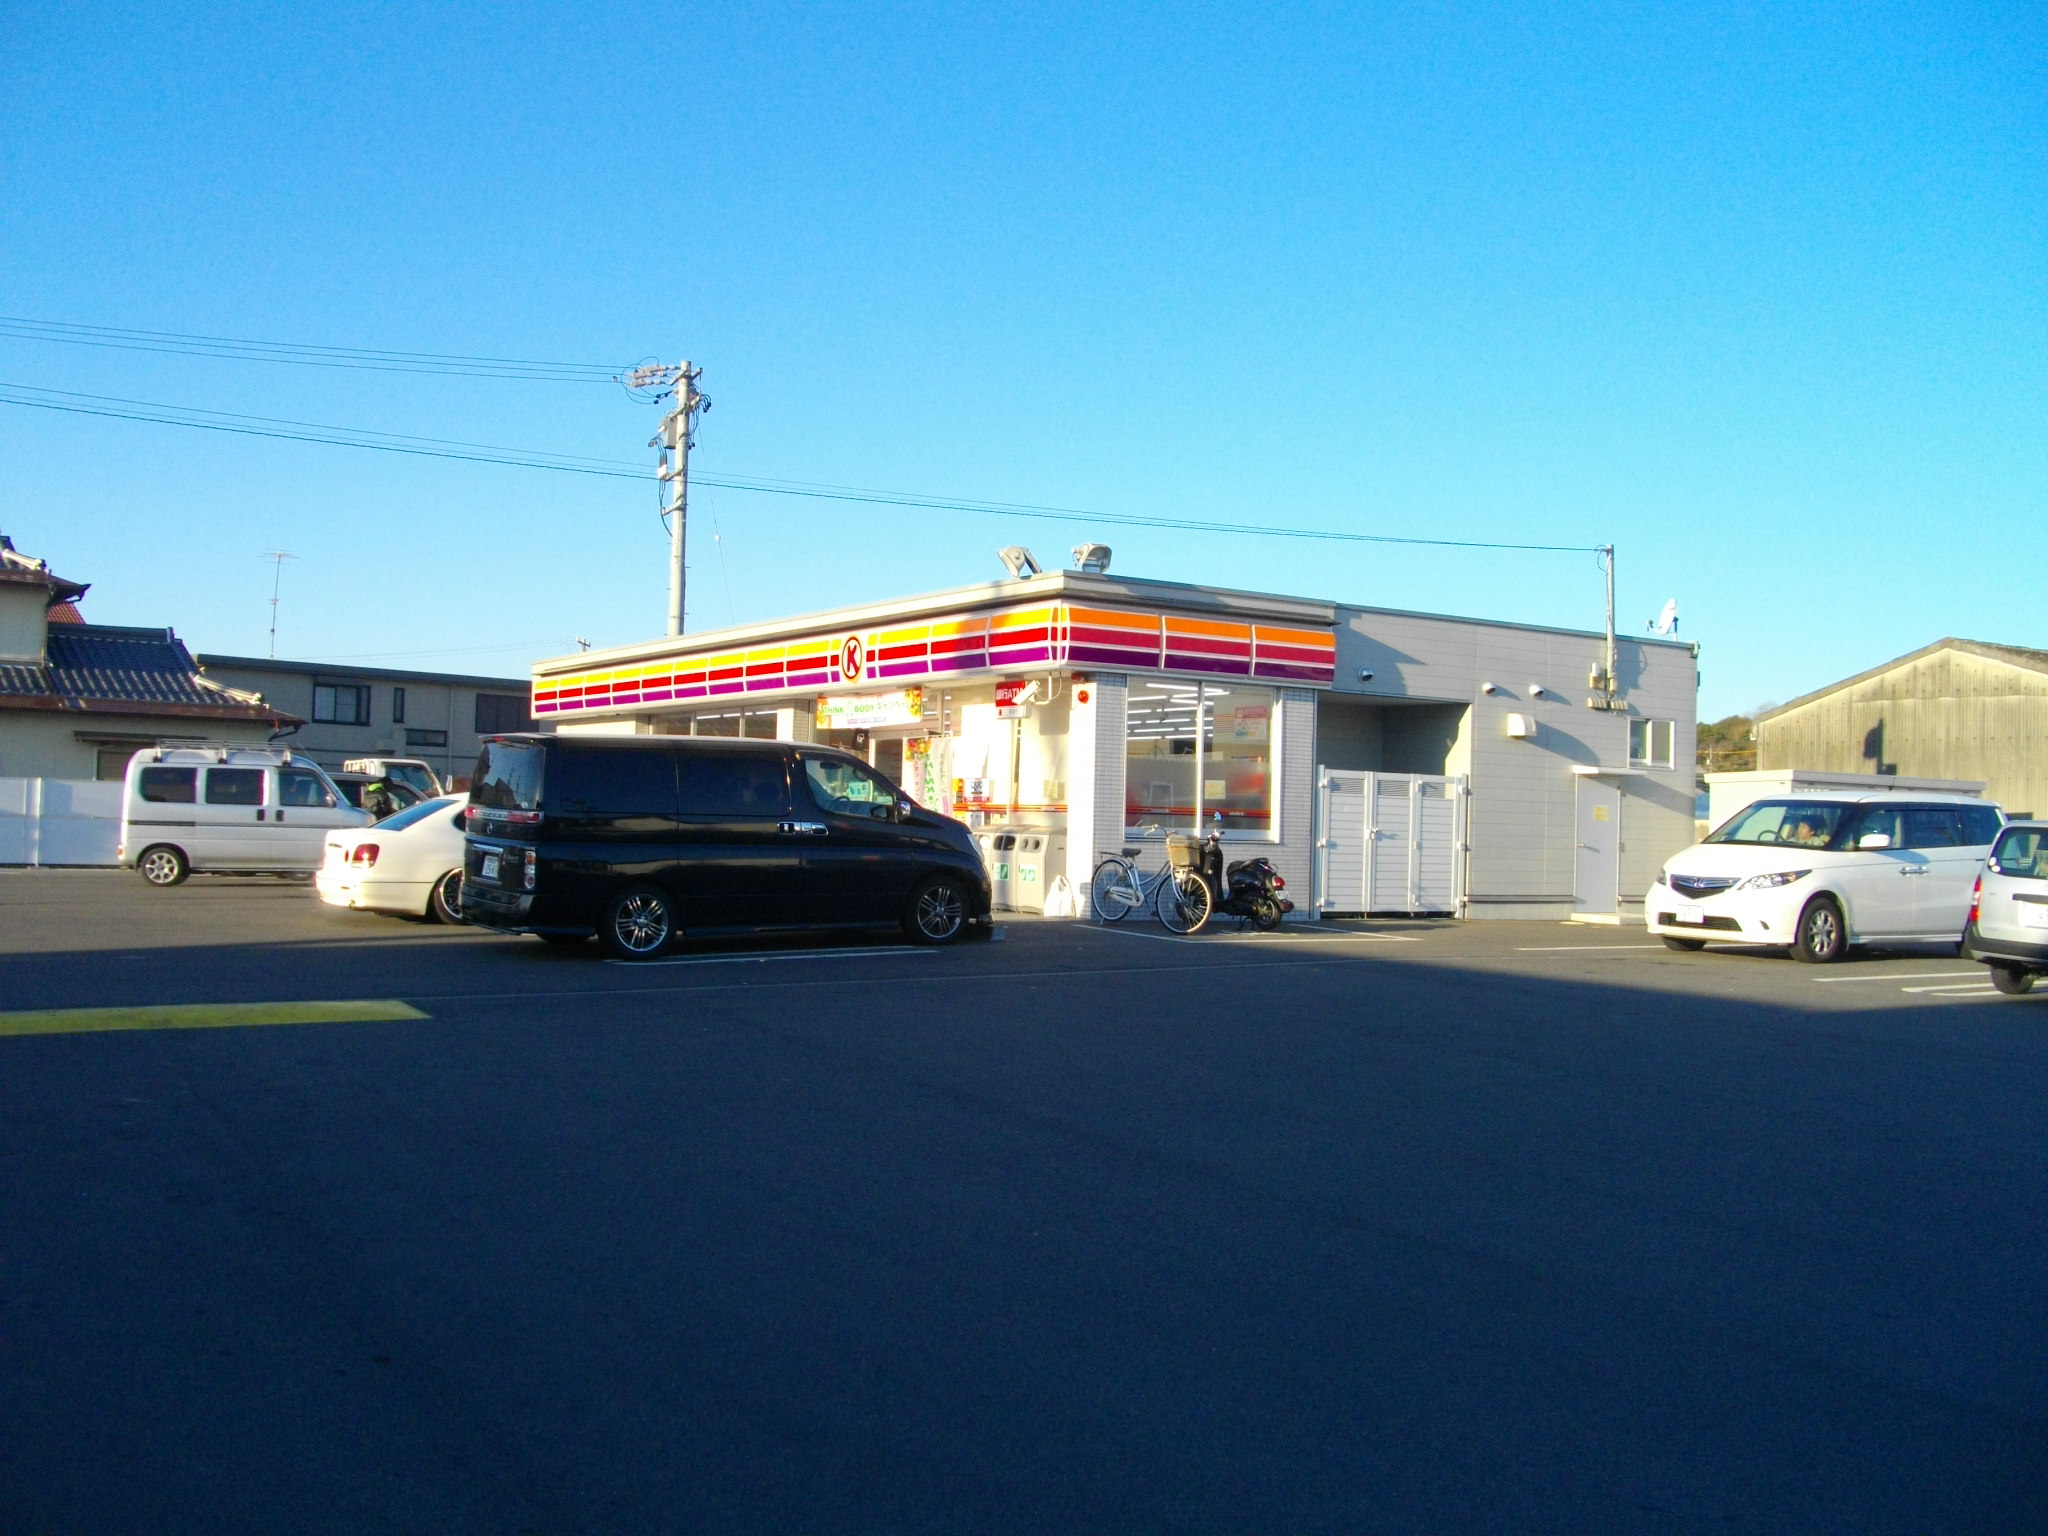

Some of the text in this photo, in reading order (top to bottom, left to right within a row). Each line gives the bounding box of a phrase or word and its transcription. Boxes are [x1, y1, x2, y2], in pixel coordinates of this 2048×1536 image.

[846, 643, 860, 675] K
[823, 706, 844, 714] THINK
[854, 704, 875, 713] BODY
